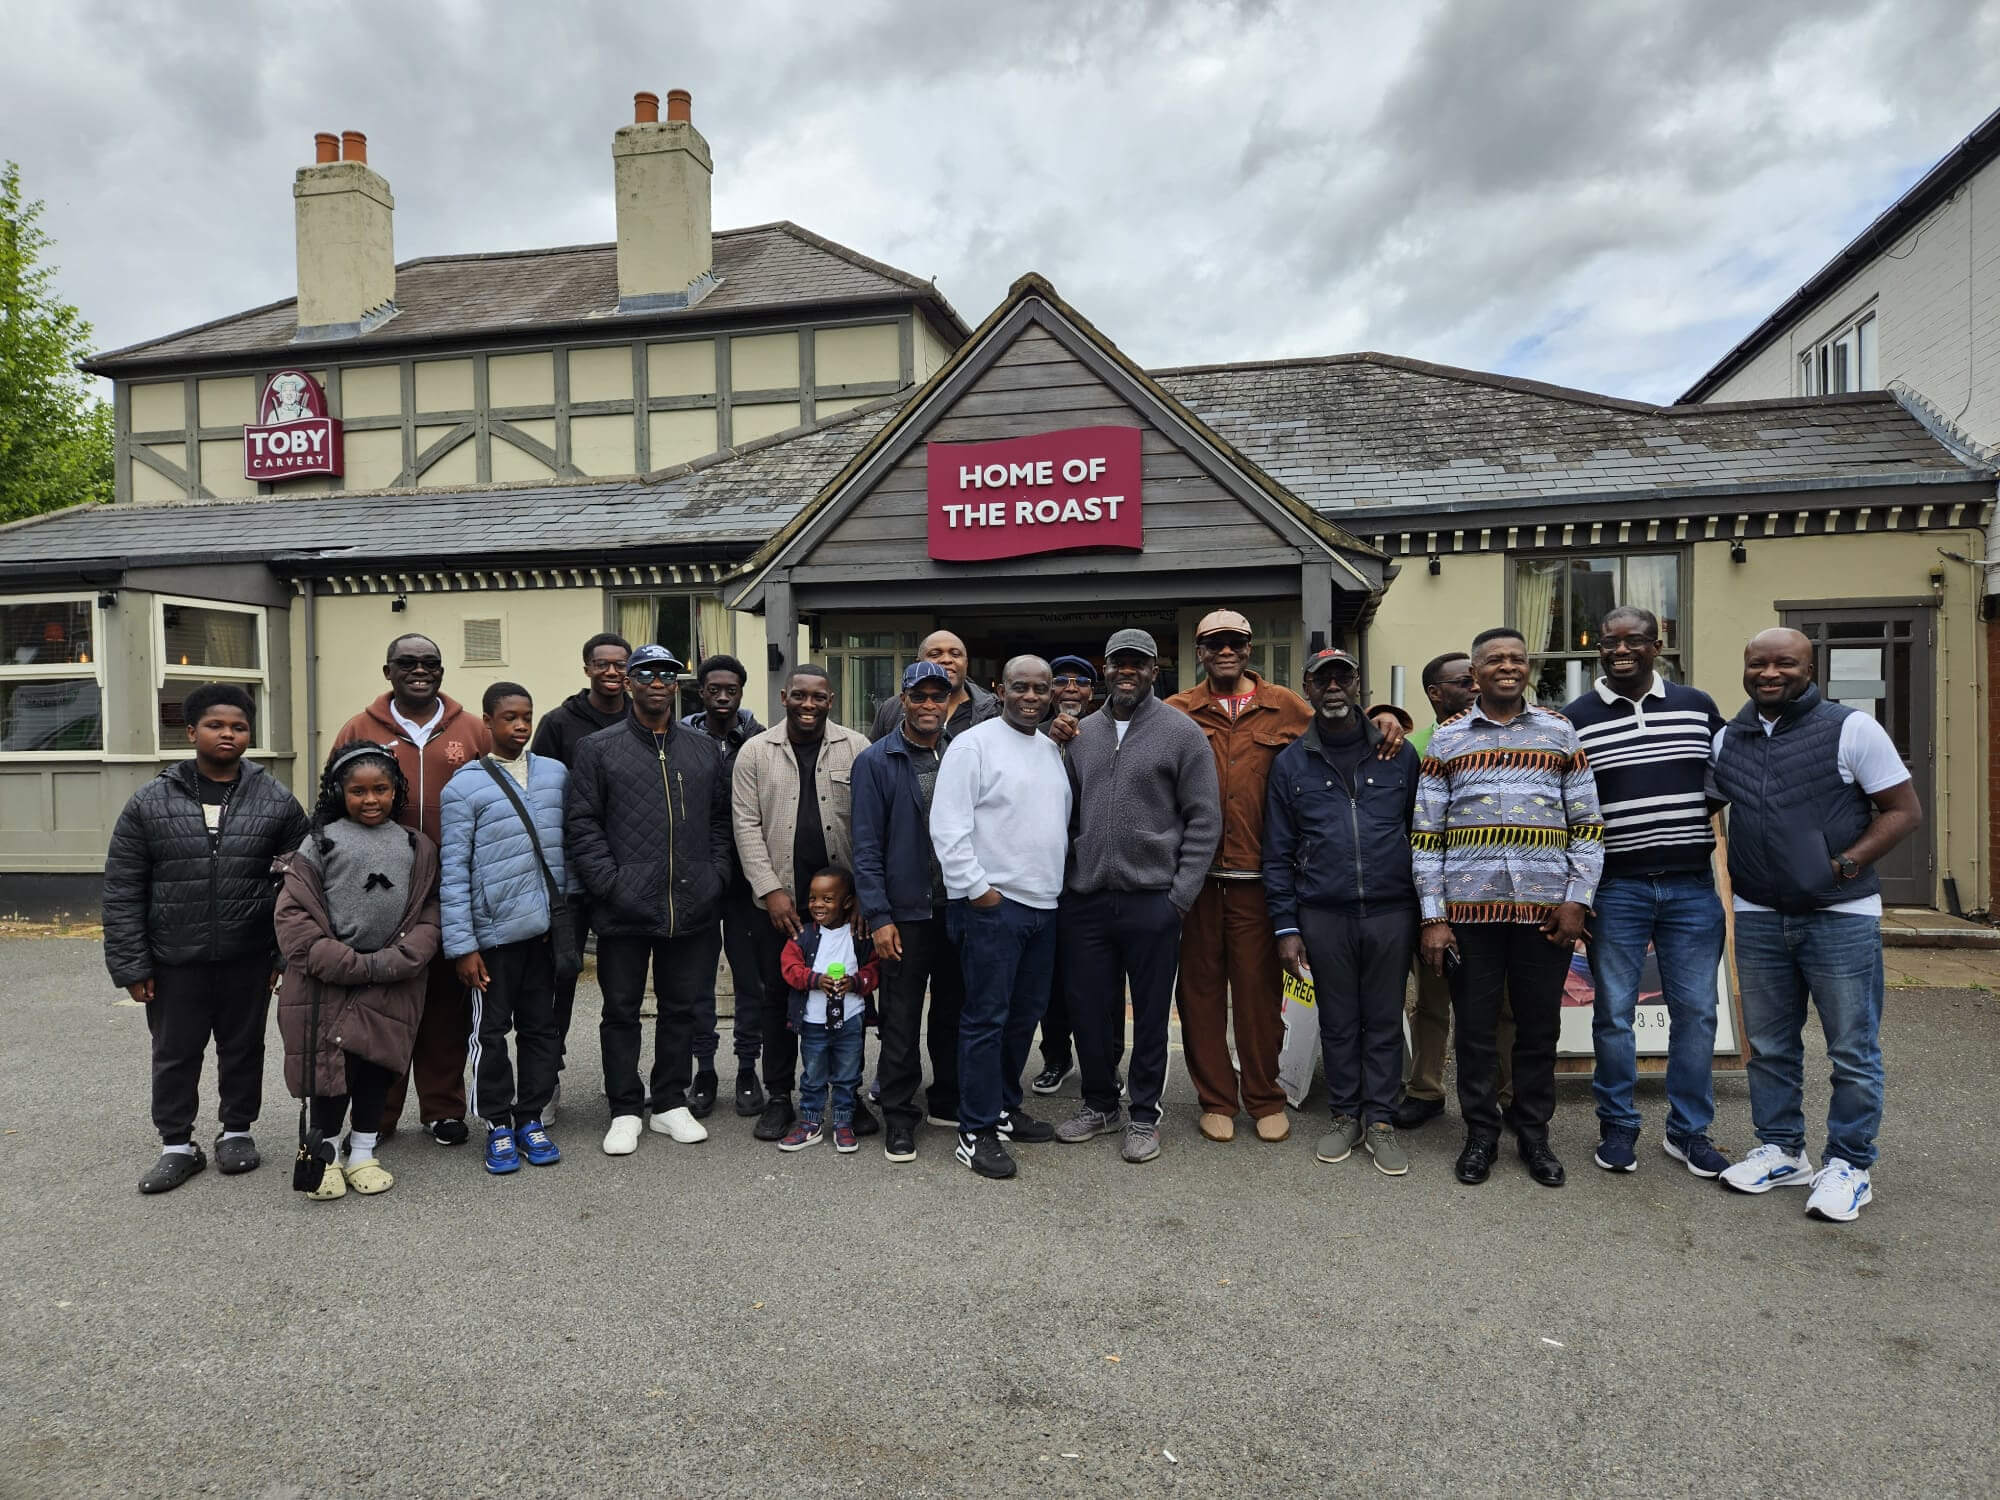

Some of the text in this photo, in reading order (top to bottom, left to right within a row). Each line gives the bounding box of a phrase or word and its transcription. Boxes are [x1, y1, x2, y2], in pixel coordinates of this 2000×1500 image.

[249, 428, 327, 456] TOBY
[253, 455, 324, 468] CARVERY
[959, 457, 1106, 490] HOME OF
[942, 495, 1125, 529] THE ROAST
